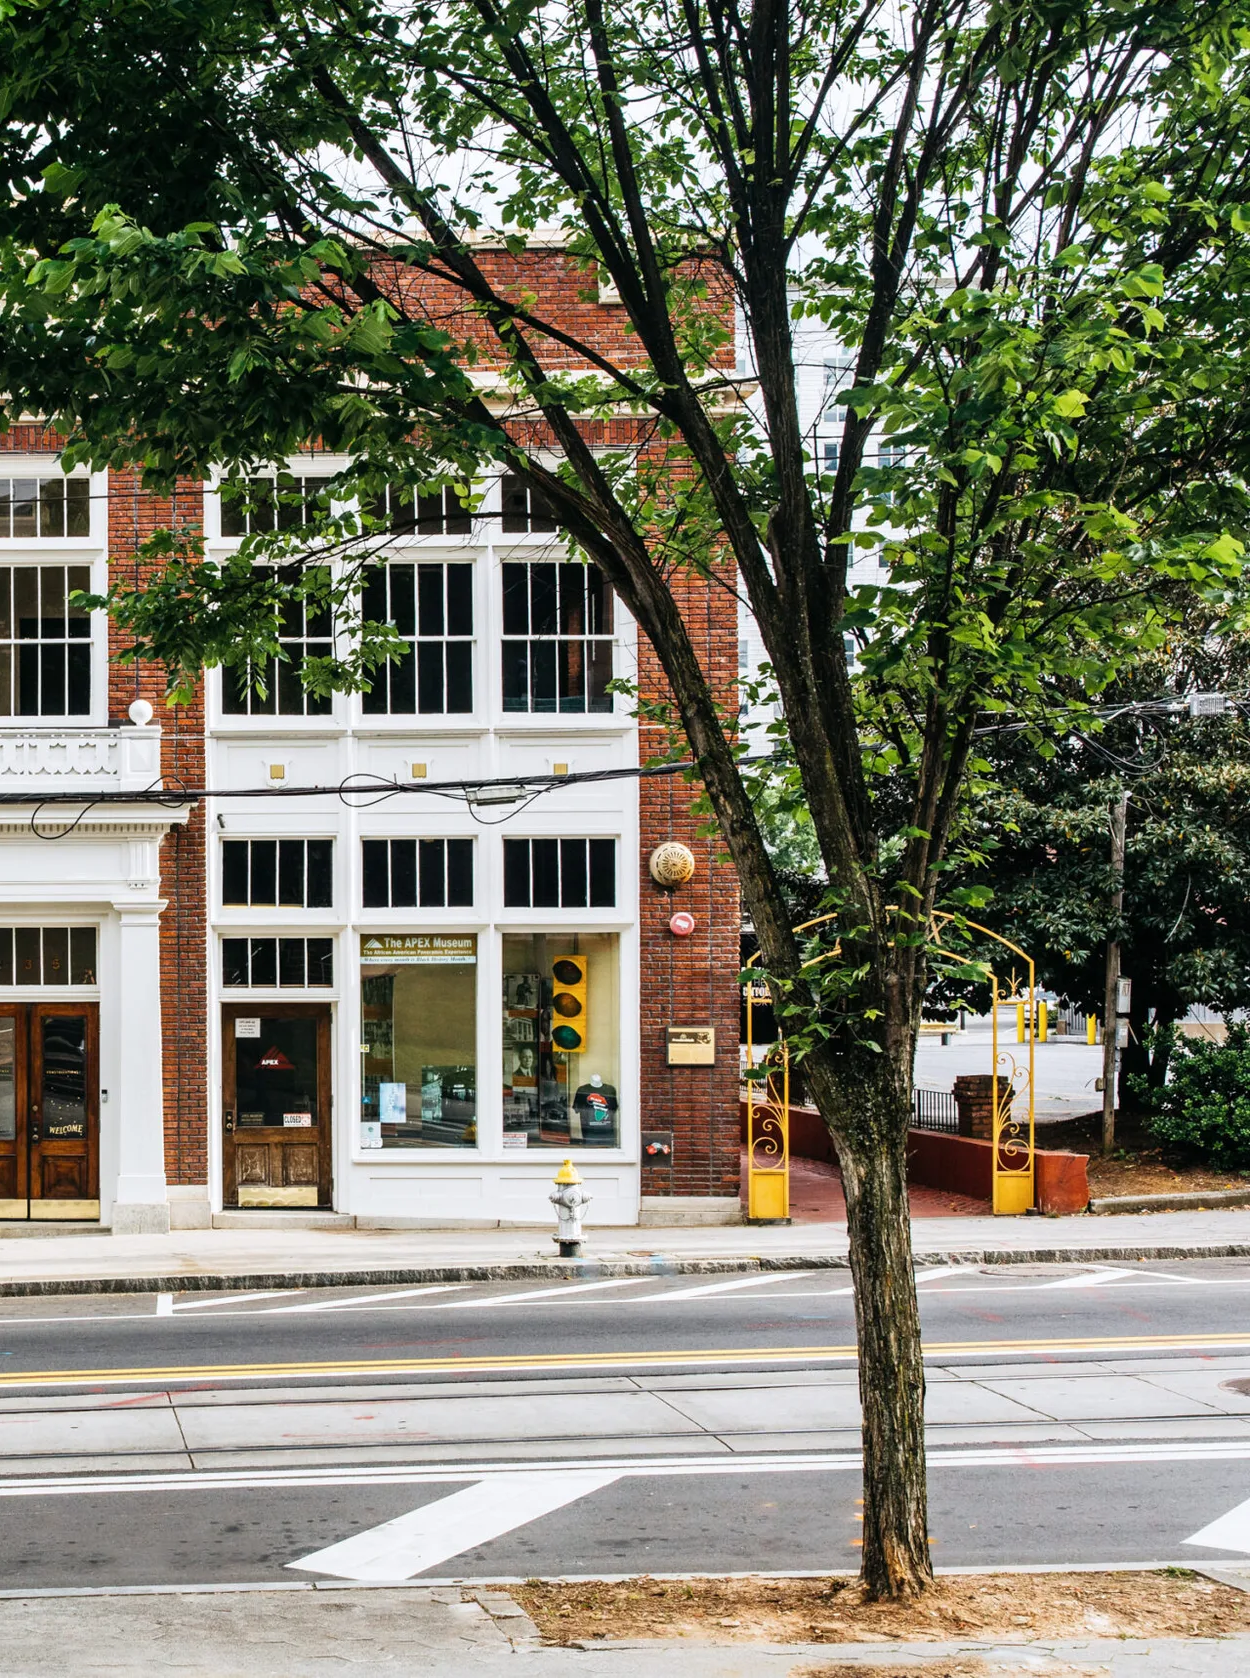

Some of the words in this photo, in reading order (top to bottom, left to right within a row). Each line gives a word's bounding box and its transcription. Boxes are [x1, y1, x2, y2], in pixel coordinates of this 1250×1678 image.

[384, 938, 402, 948] The
[405, 938, 431, 948] APEX
[433, 937, 472, 948] Museum
[284, 1115, 302, 1124] CLOSED
[49, 1124, 84, 1134] WELCOME
